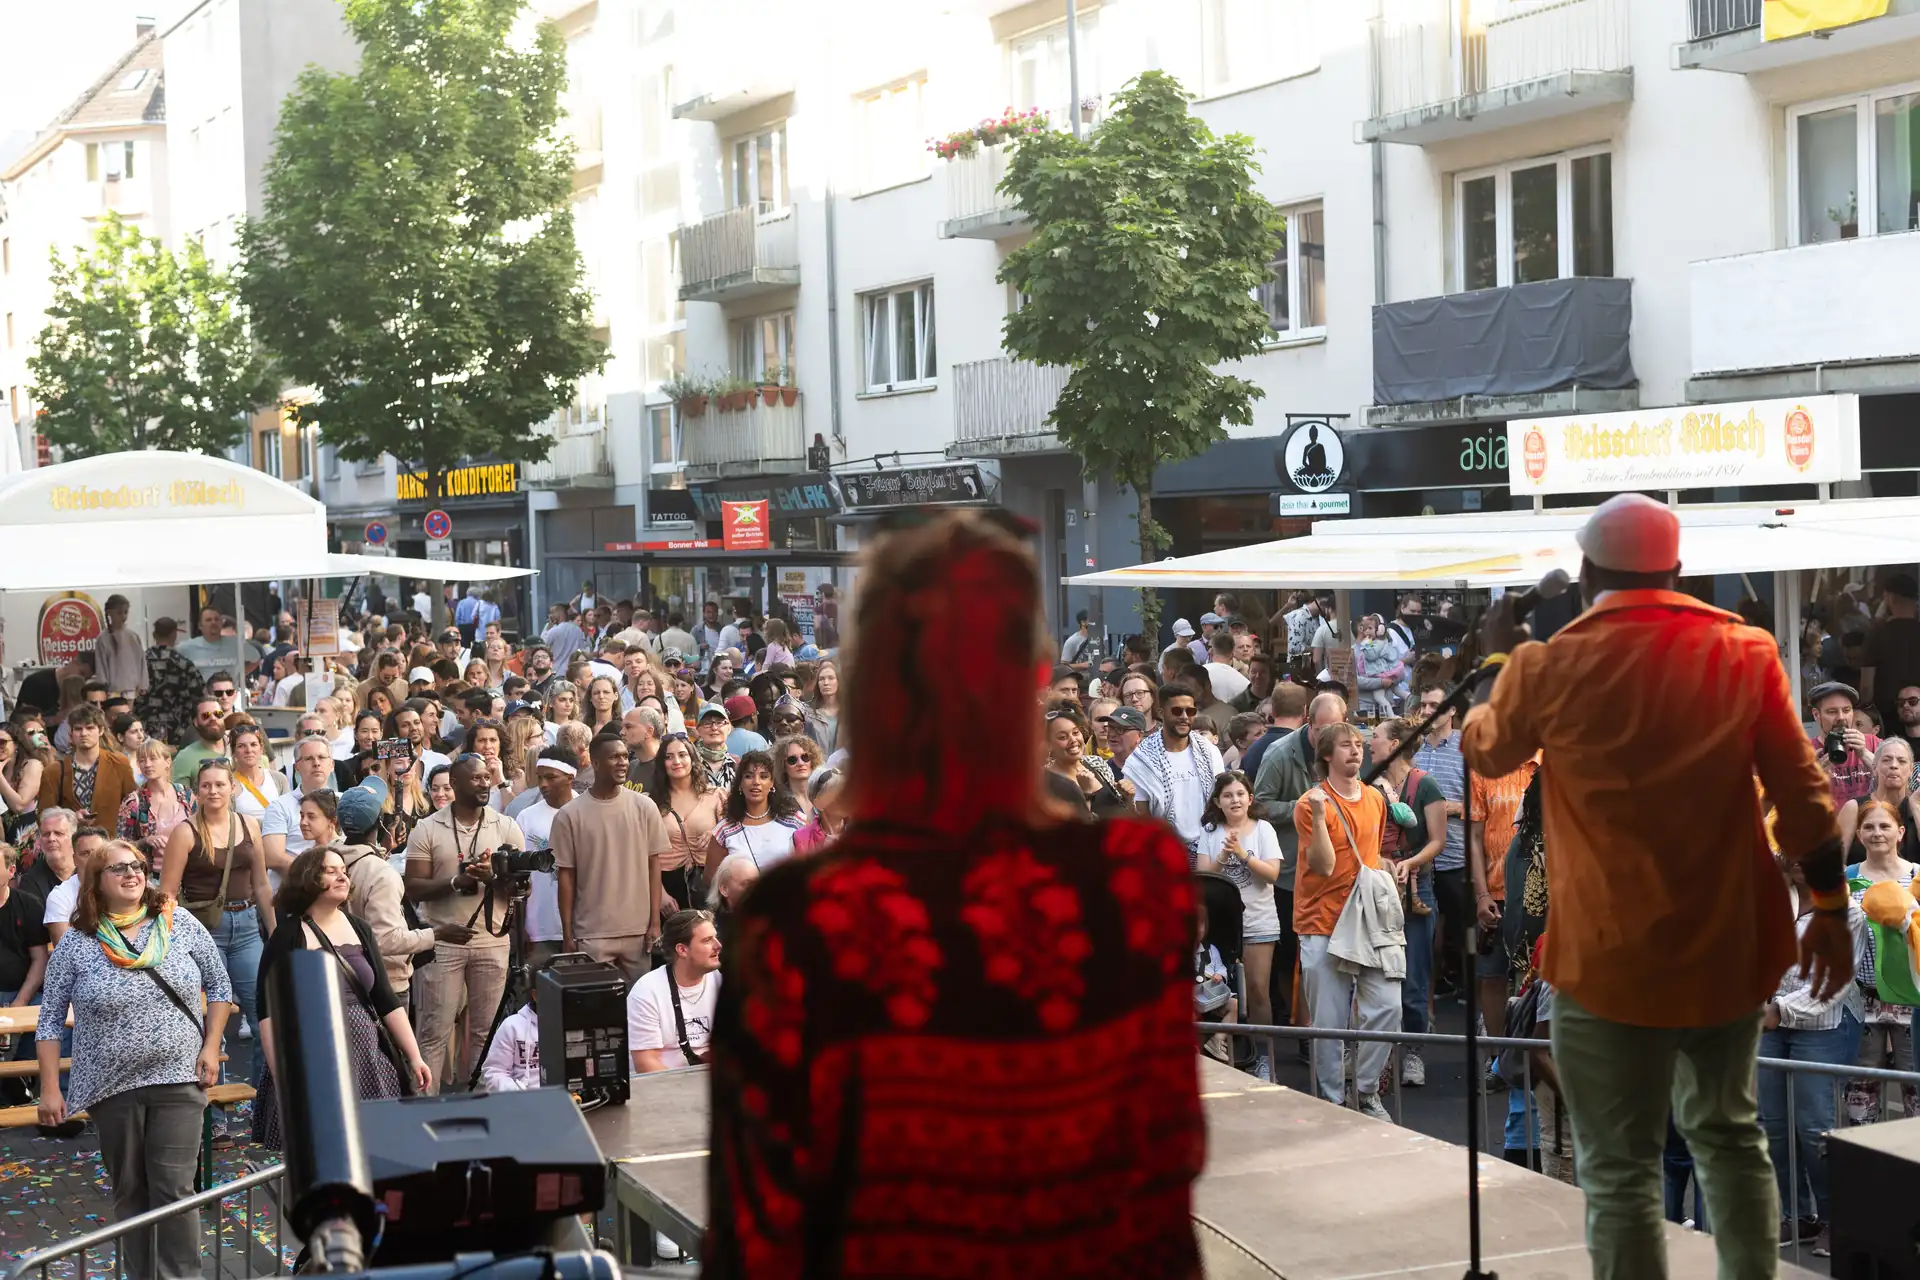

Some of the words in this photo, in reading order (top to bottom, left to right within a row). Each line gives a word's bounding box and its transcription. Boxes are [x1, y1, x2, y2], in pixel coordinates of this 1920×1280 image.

[1563, 417, 1672, 460] Reissdorf
[1679, 407, 1766, 458] Kölsch
[1460, 428, 1509, 471] asia
[51, 484, 160, 510] Reissdorf
[168, 476, 245, 510] Kölsch
[446, 463, 515, 496] KONDITOREI
[775, 485, 832, 512] EMLAK
[1281, 501, 1296, 510] asia
[1297, 499, 1309, 509] thai
[1318, 499, 1349, 512] gourmet
[650, 512, 689, 522] TATTOO
[668, 540, 694, 550] Bonner
[694, 540, 709, 549] Wall
[43, 636, 97, 652] Reissdor
